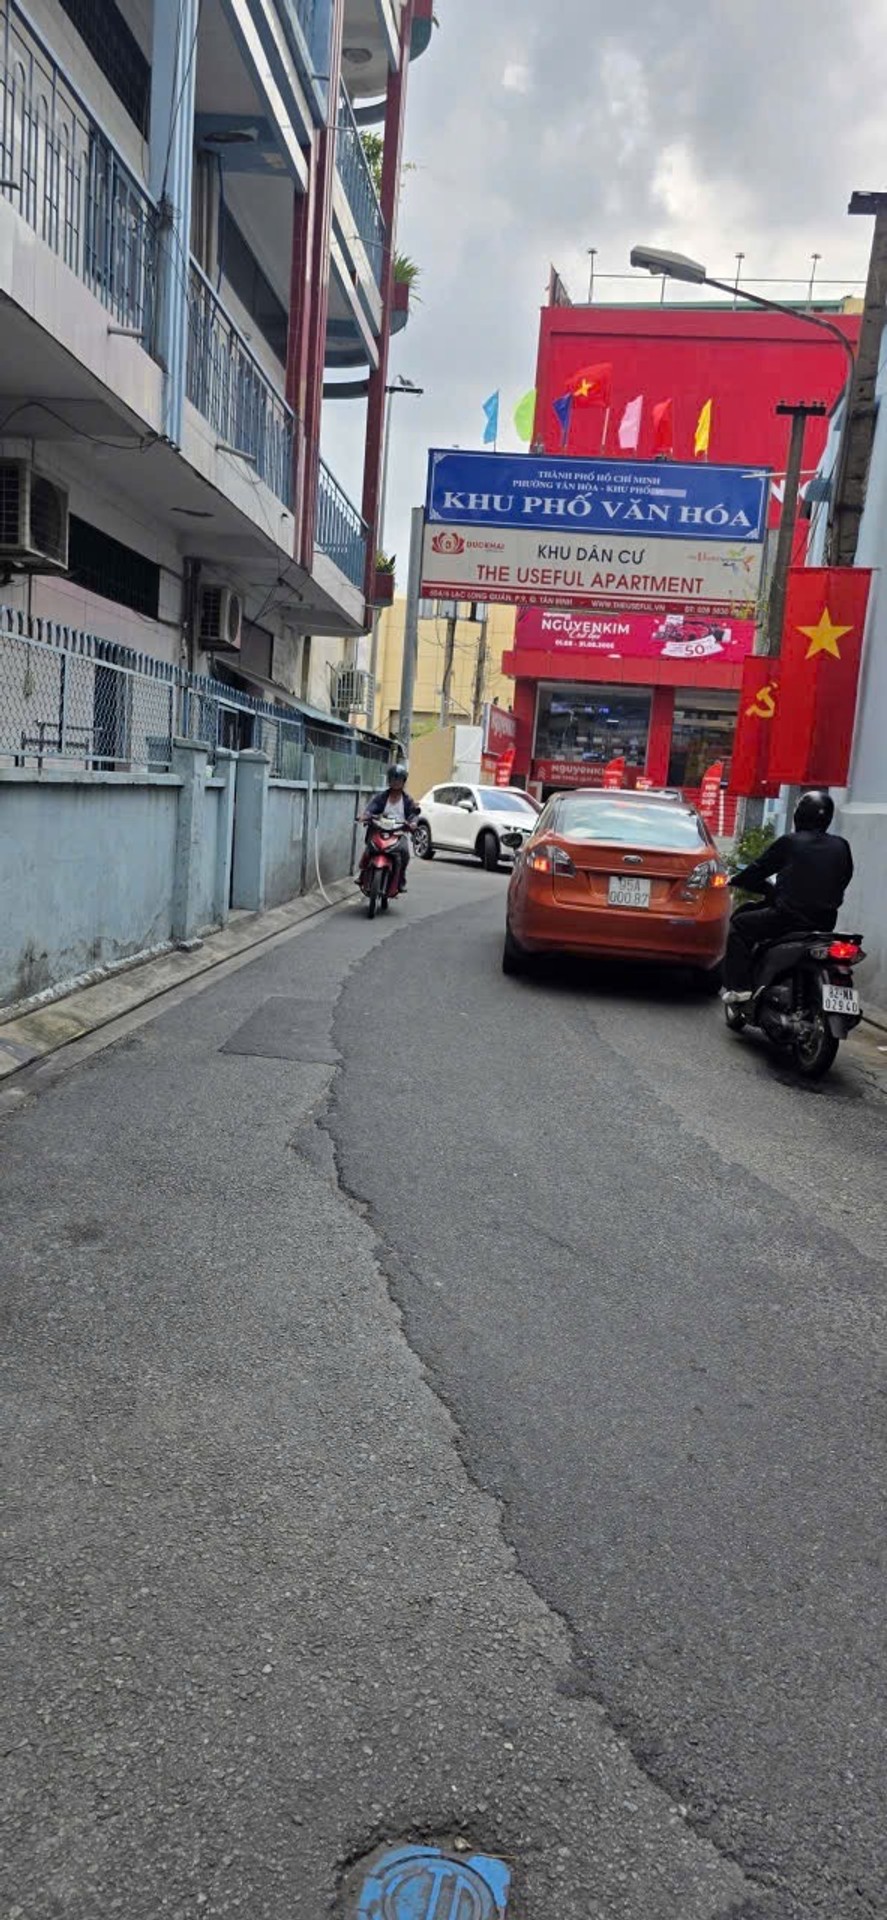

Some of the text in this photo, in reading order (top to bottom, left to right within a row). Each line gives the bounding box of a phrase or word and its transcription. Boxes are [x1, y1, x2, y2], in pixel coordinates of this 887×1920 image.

[512, 479, 553, 489] PHƯỜNG
[556, 480, 576, 490] TÂN
[606, 484, 629, 494] KHU
[630, 484, 651, 495] PHỐ
[539, 470, 660, 485] THÀNH PHỐ HỒ CHÍ MINH
[443, 491, 752, 527] KHU PHỐ VĂN HÓA
[538, 543, 645, 565] KHU DÂN CƯ
[477, 564, 705, 594] THE USEFUL APARTMENT
[541, 619, 630, 634] NGUYENKIM
